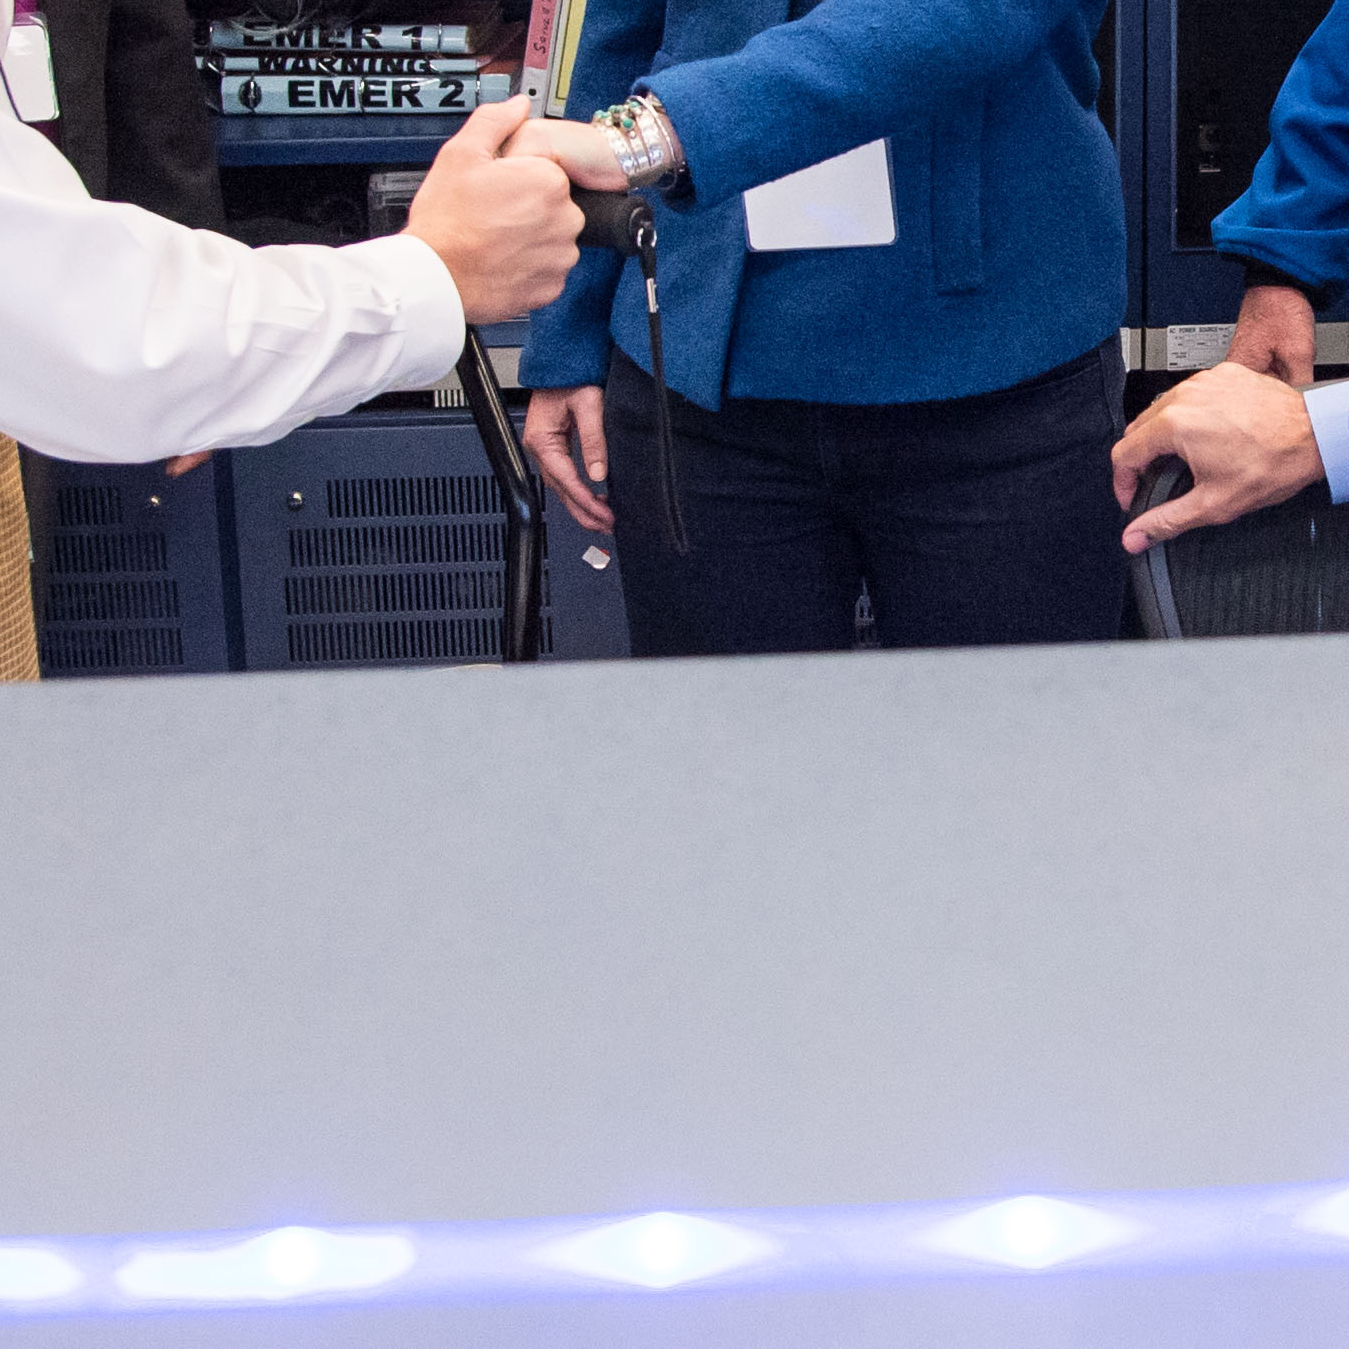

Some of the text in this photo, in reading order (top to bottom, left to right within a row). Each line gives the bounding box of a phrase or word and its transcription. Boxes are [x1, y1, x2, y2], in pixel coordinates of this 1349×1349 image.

[244, 21, 423, 50] EMER 1
[257, 57, 435, 74] WARNING
[287, 80, 466, 108] EMER 2
